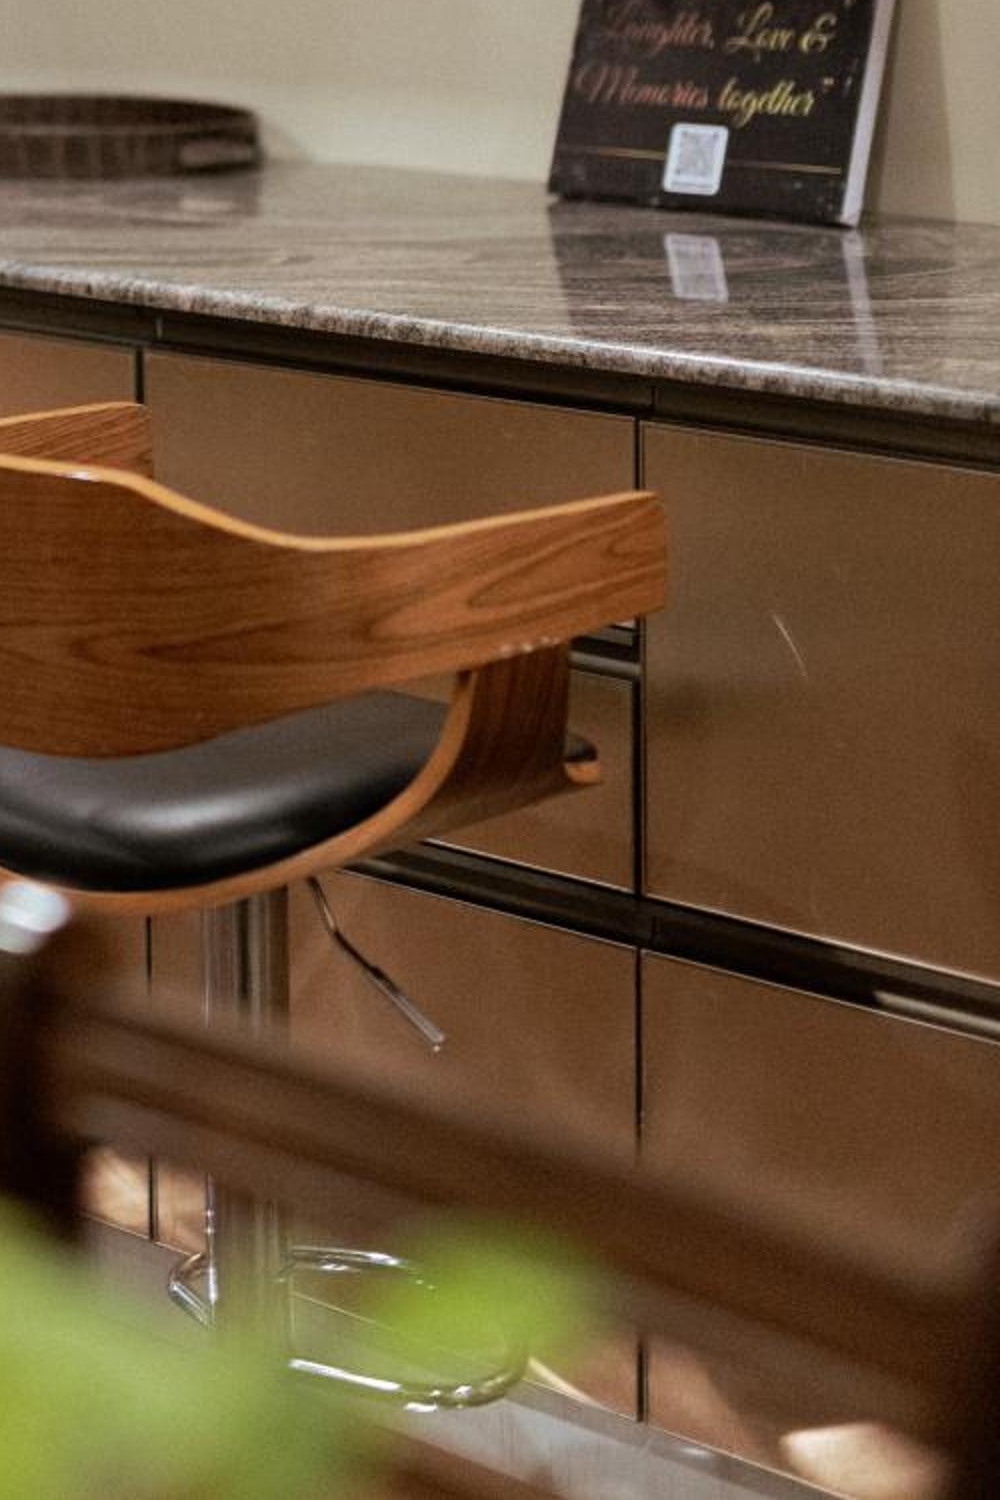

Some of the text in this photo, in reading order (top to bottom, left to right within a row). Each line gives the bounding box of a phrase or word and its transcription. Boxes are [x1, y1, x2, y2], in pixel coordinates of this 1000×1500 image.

[727, 2, 795, 62] Love
[799, 12, 838, 54] &
[574, 65, 709, 106] Memories
